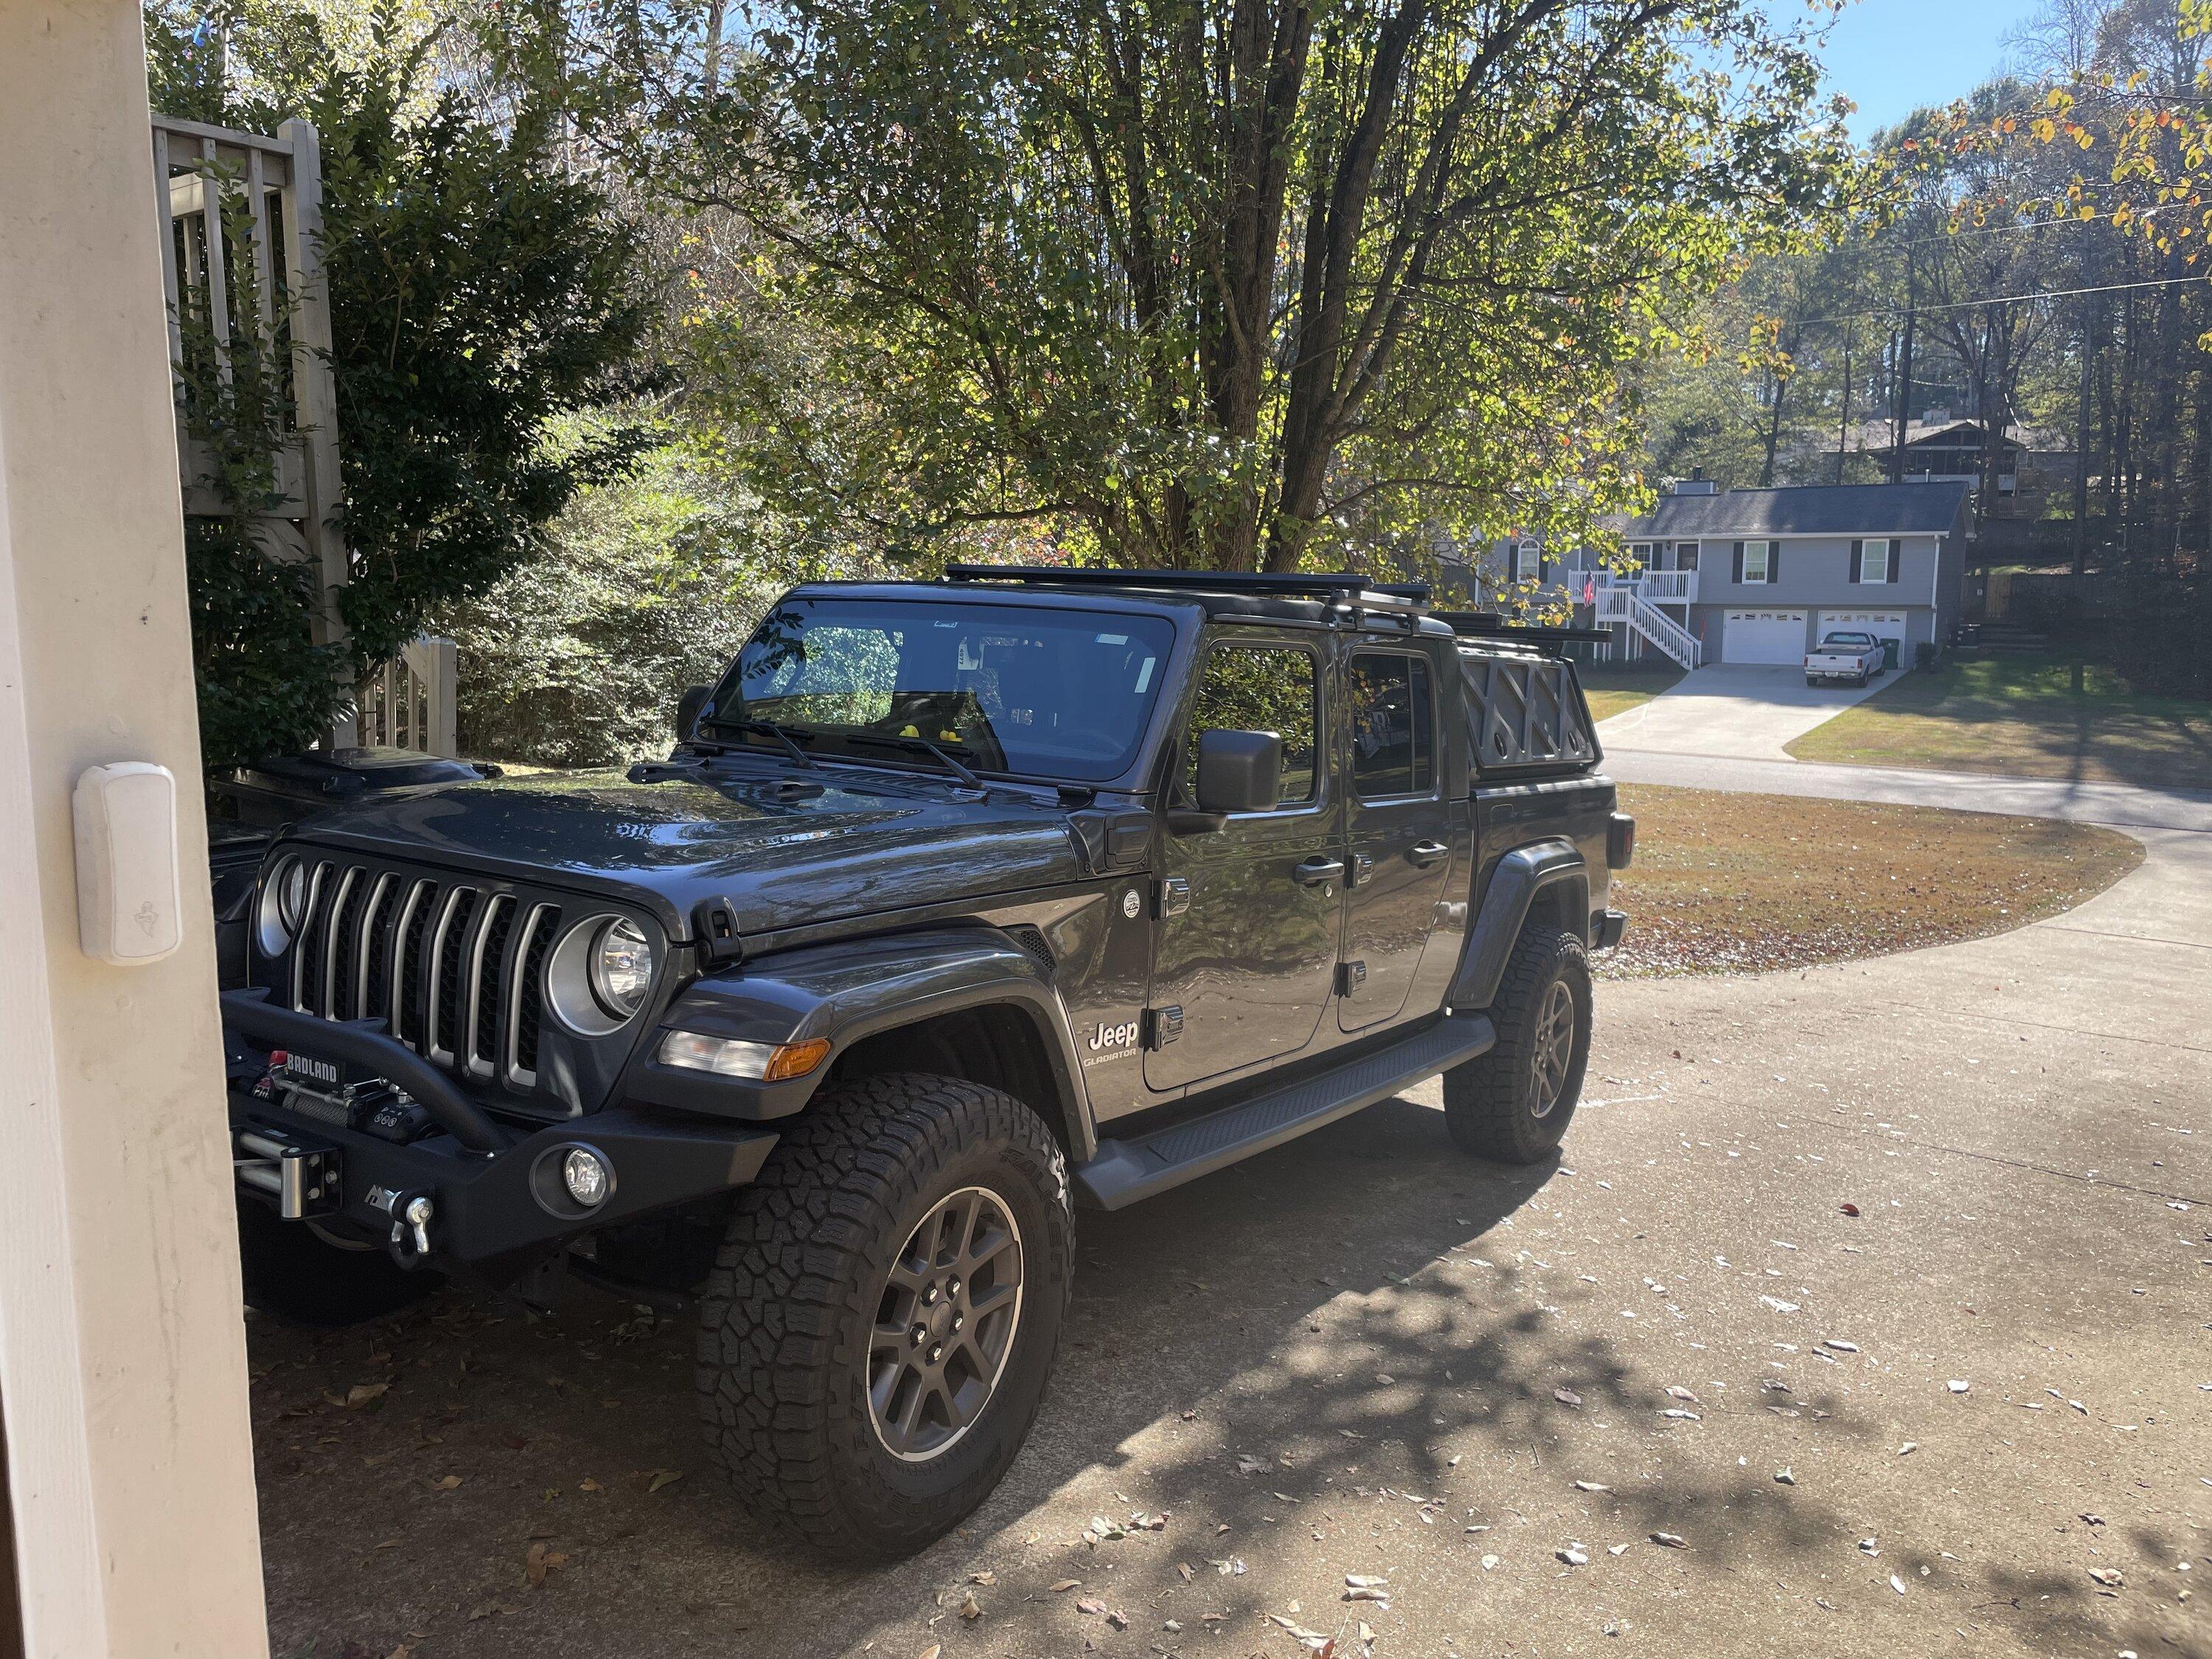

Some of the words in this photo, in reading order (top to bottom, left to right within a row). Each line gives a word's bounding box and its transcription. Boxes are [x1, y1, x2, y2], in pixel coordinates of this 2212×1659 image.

[1088, 1021, 1138, 1051] Jeep
[288, 1053, 337, 1083] BADLAND
[1083, 1048, 1136, 1067] GLADIATOR
